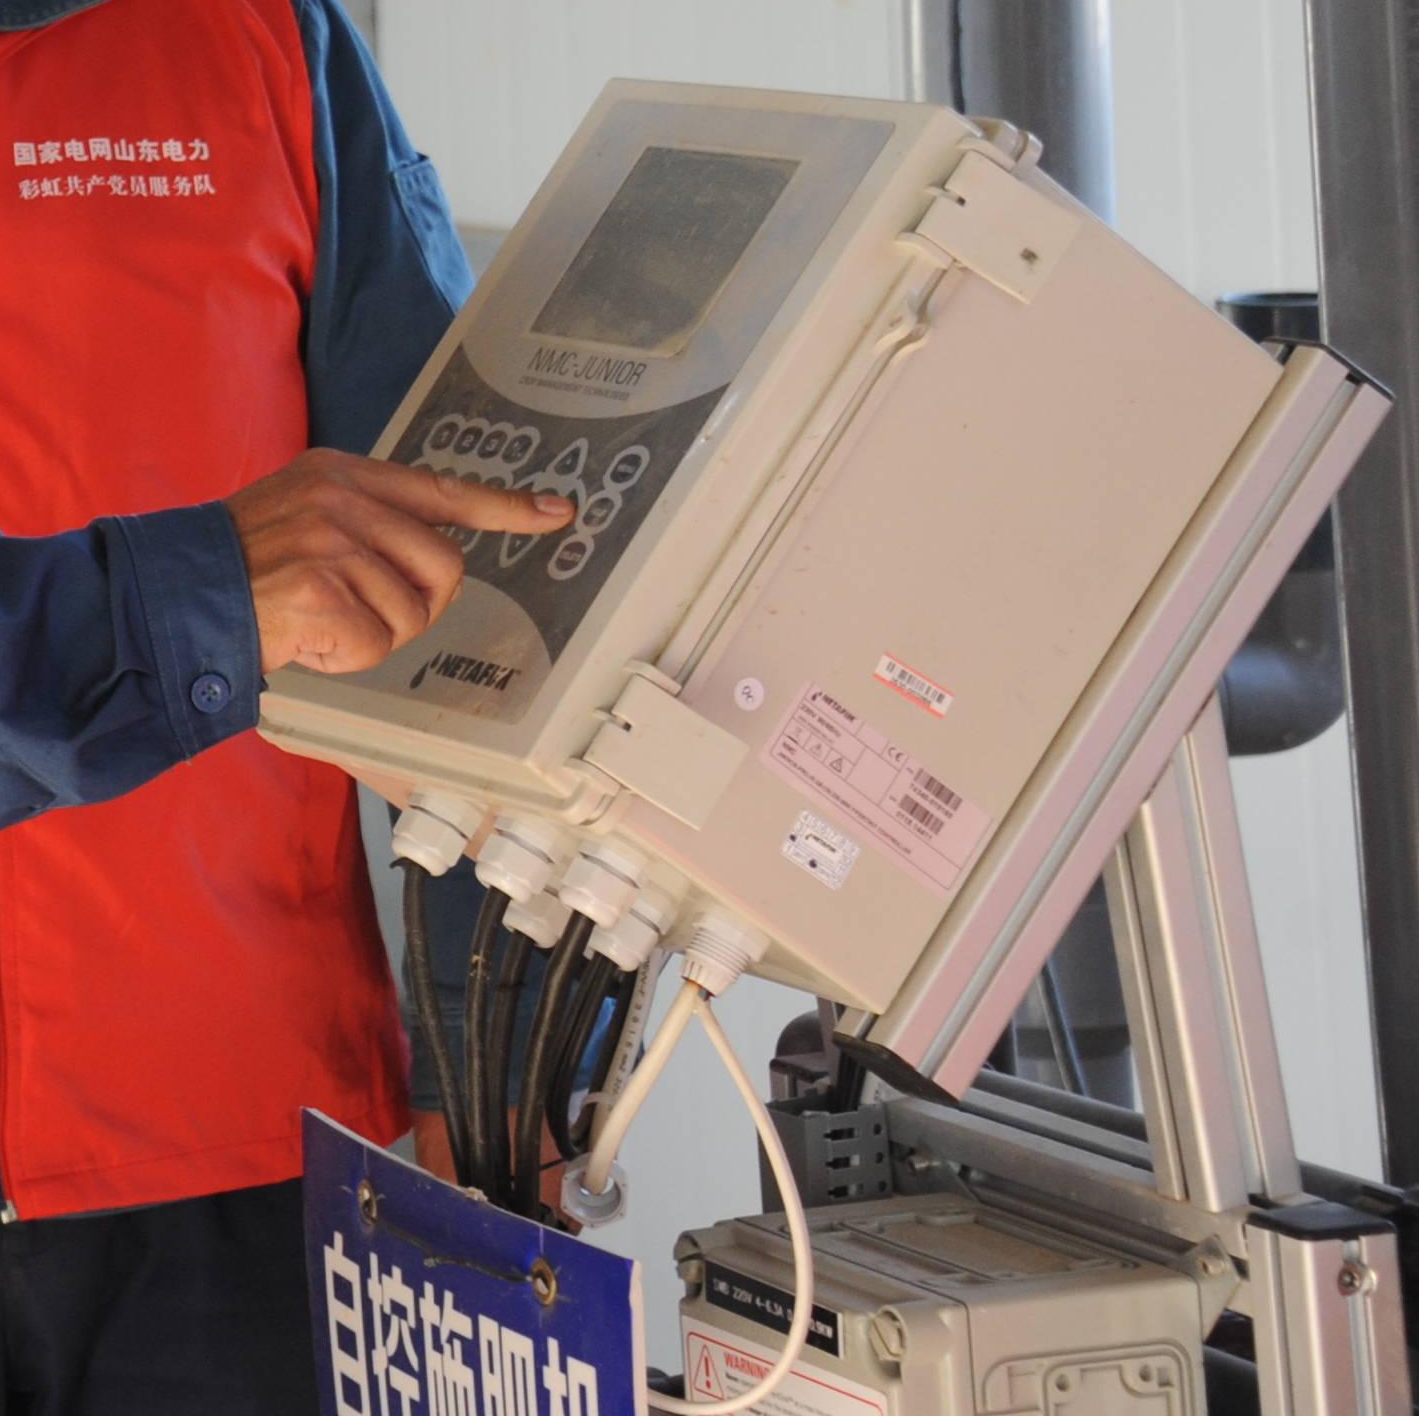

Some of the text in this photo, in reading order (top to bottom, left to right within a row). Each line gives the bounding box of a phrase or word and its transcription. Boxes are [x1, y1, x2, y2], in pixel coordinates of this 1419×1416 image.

[13, 138, 211, 167] 国家电网山东电力
[19, 174, 216, 200] 彩虹共产党员服务队
[526, 347, 647, 386] NMC-JUNIOR
[822, 693, 856, 723] NETAFIM
